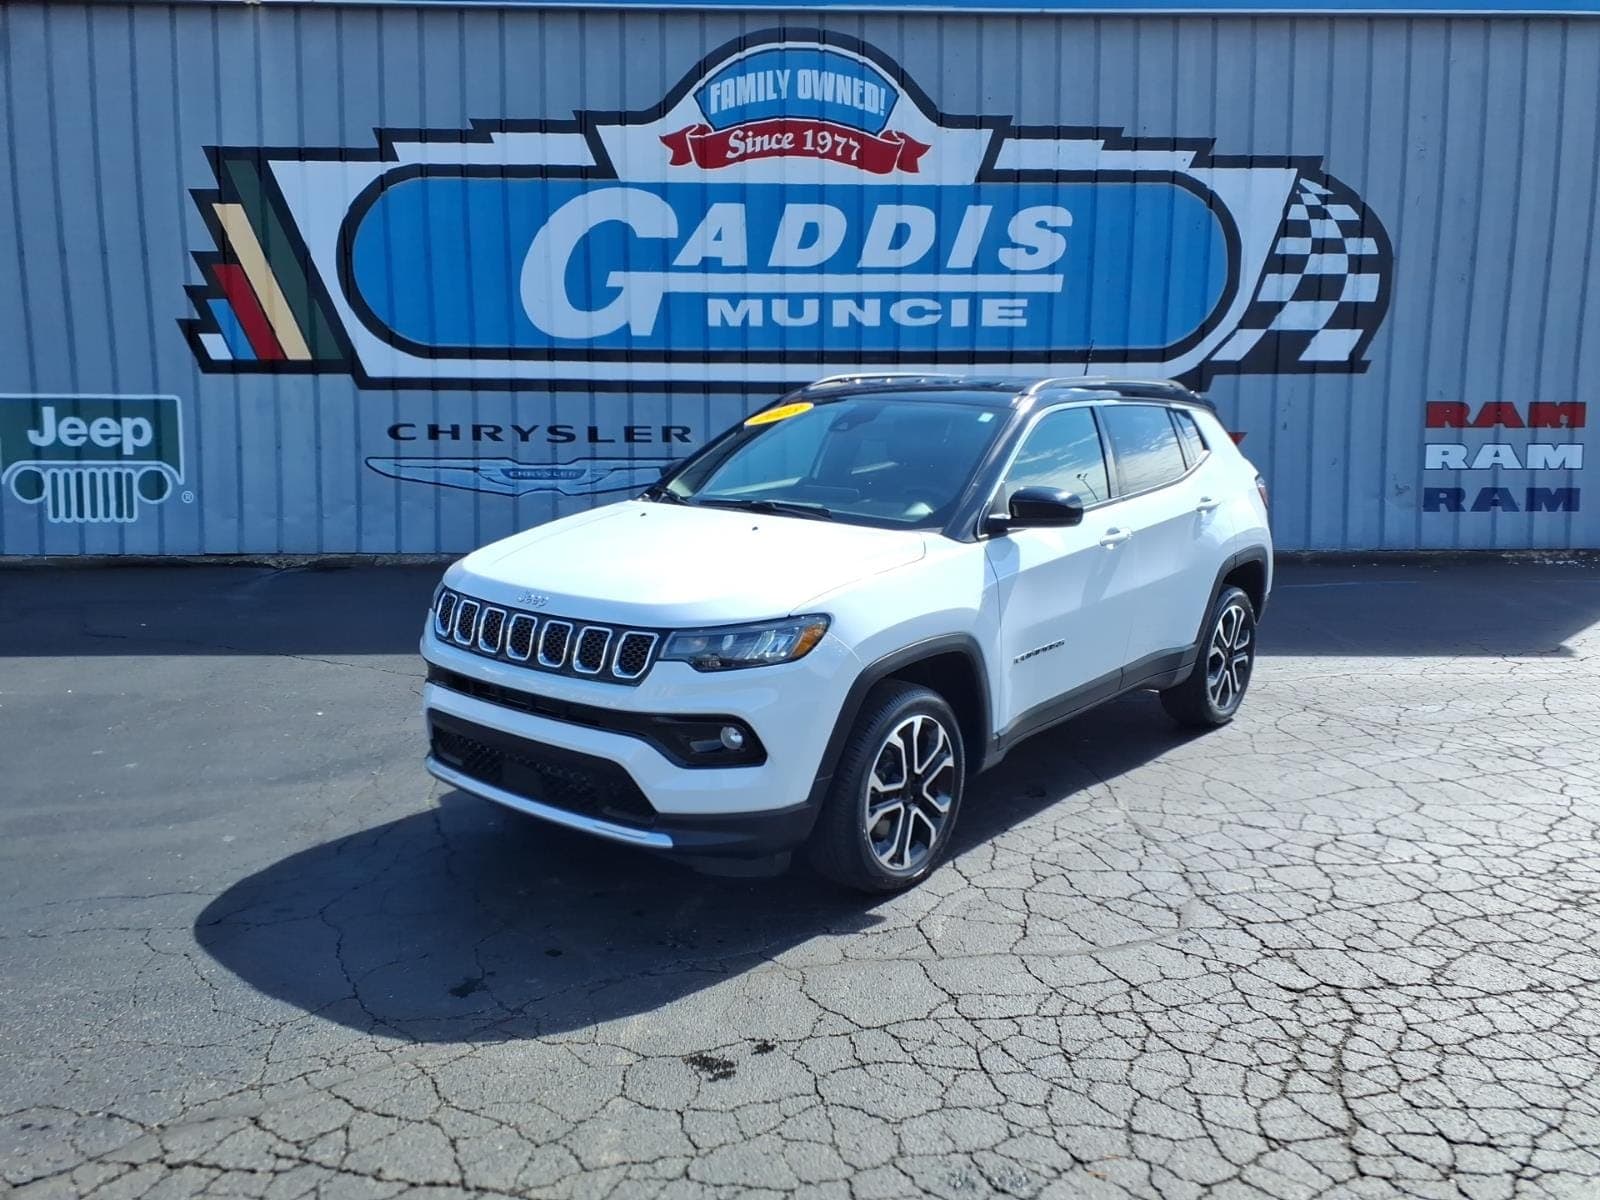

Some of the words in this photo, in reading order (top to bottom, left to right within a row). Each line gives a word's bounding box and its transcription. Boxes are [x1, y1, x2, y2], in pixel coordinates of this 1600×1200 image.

[710, 69, 790, 115] FAMILY
[797, 69, 886, 116] OWNED!
[726, 129, 795, 159] Since
[802, 129, 861, 161] 1977
[520, 187, 1073, 339] GADDIS
[707, 298, 1028, 327] MUNCIE
[1425, 401, 1586, 428] RAM
[27, 406, 152, 455] Jeep
[387, 423, 692, 443] CHRYSLER
[1424, 443, 1584, 470] RAM
[509, 470, 577, 478] CHRYSLER
[1423, 487, 1581, 512] RAM
